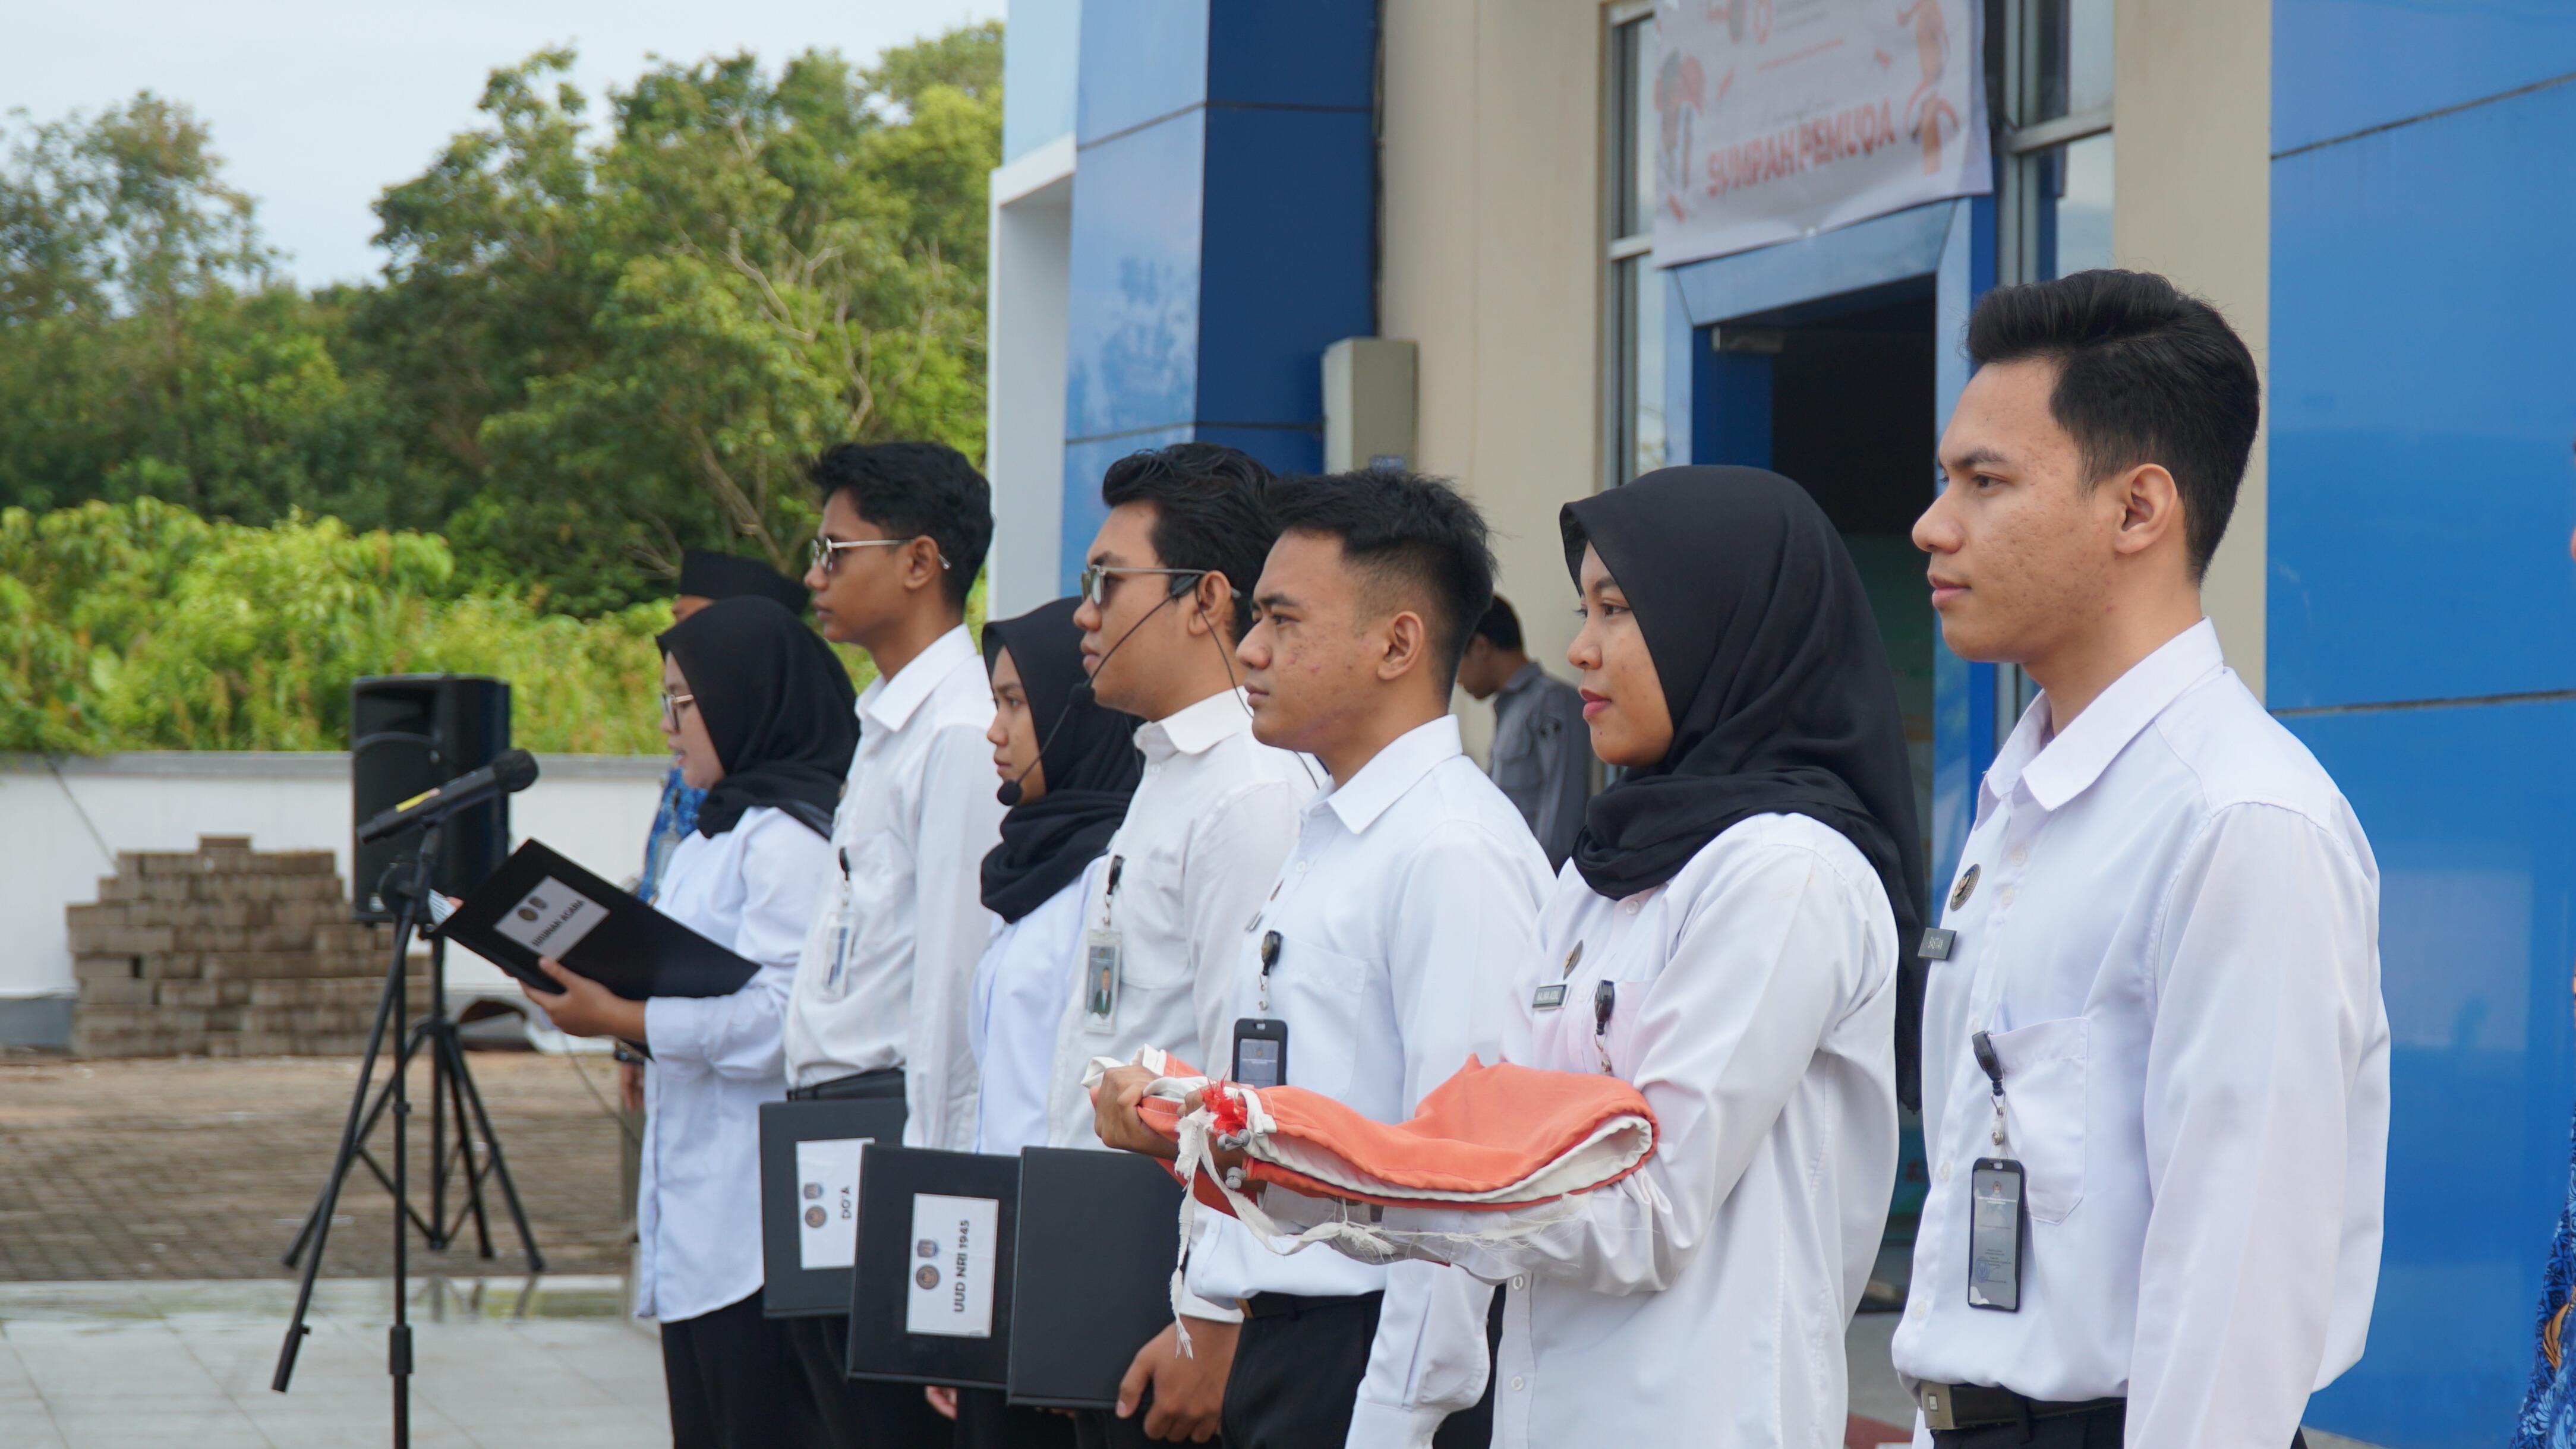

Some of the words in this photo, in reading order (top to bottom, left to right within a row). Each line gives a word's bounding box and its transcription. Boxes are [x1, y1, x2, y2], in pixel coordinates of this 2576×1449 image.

[840, 1186, 853, 1220] DO'A
[958, 1219, 970, 1249] 1945
[956, 1252, 968, 1278] NRI
[953, 1281, 966, 1313] UUD
